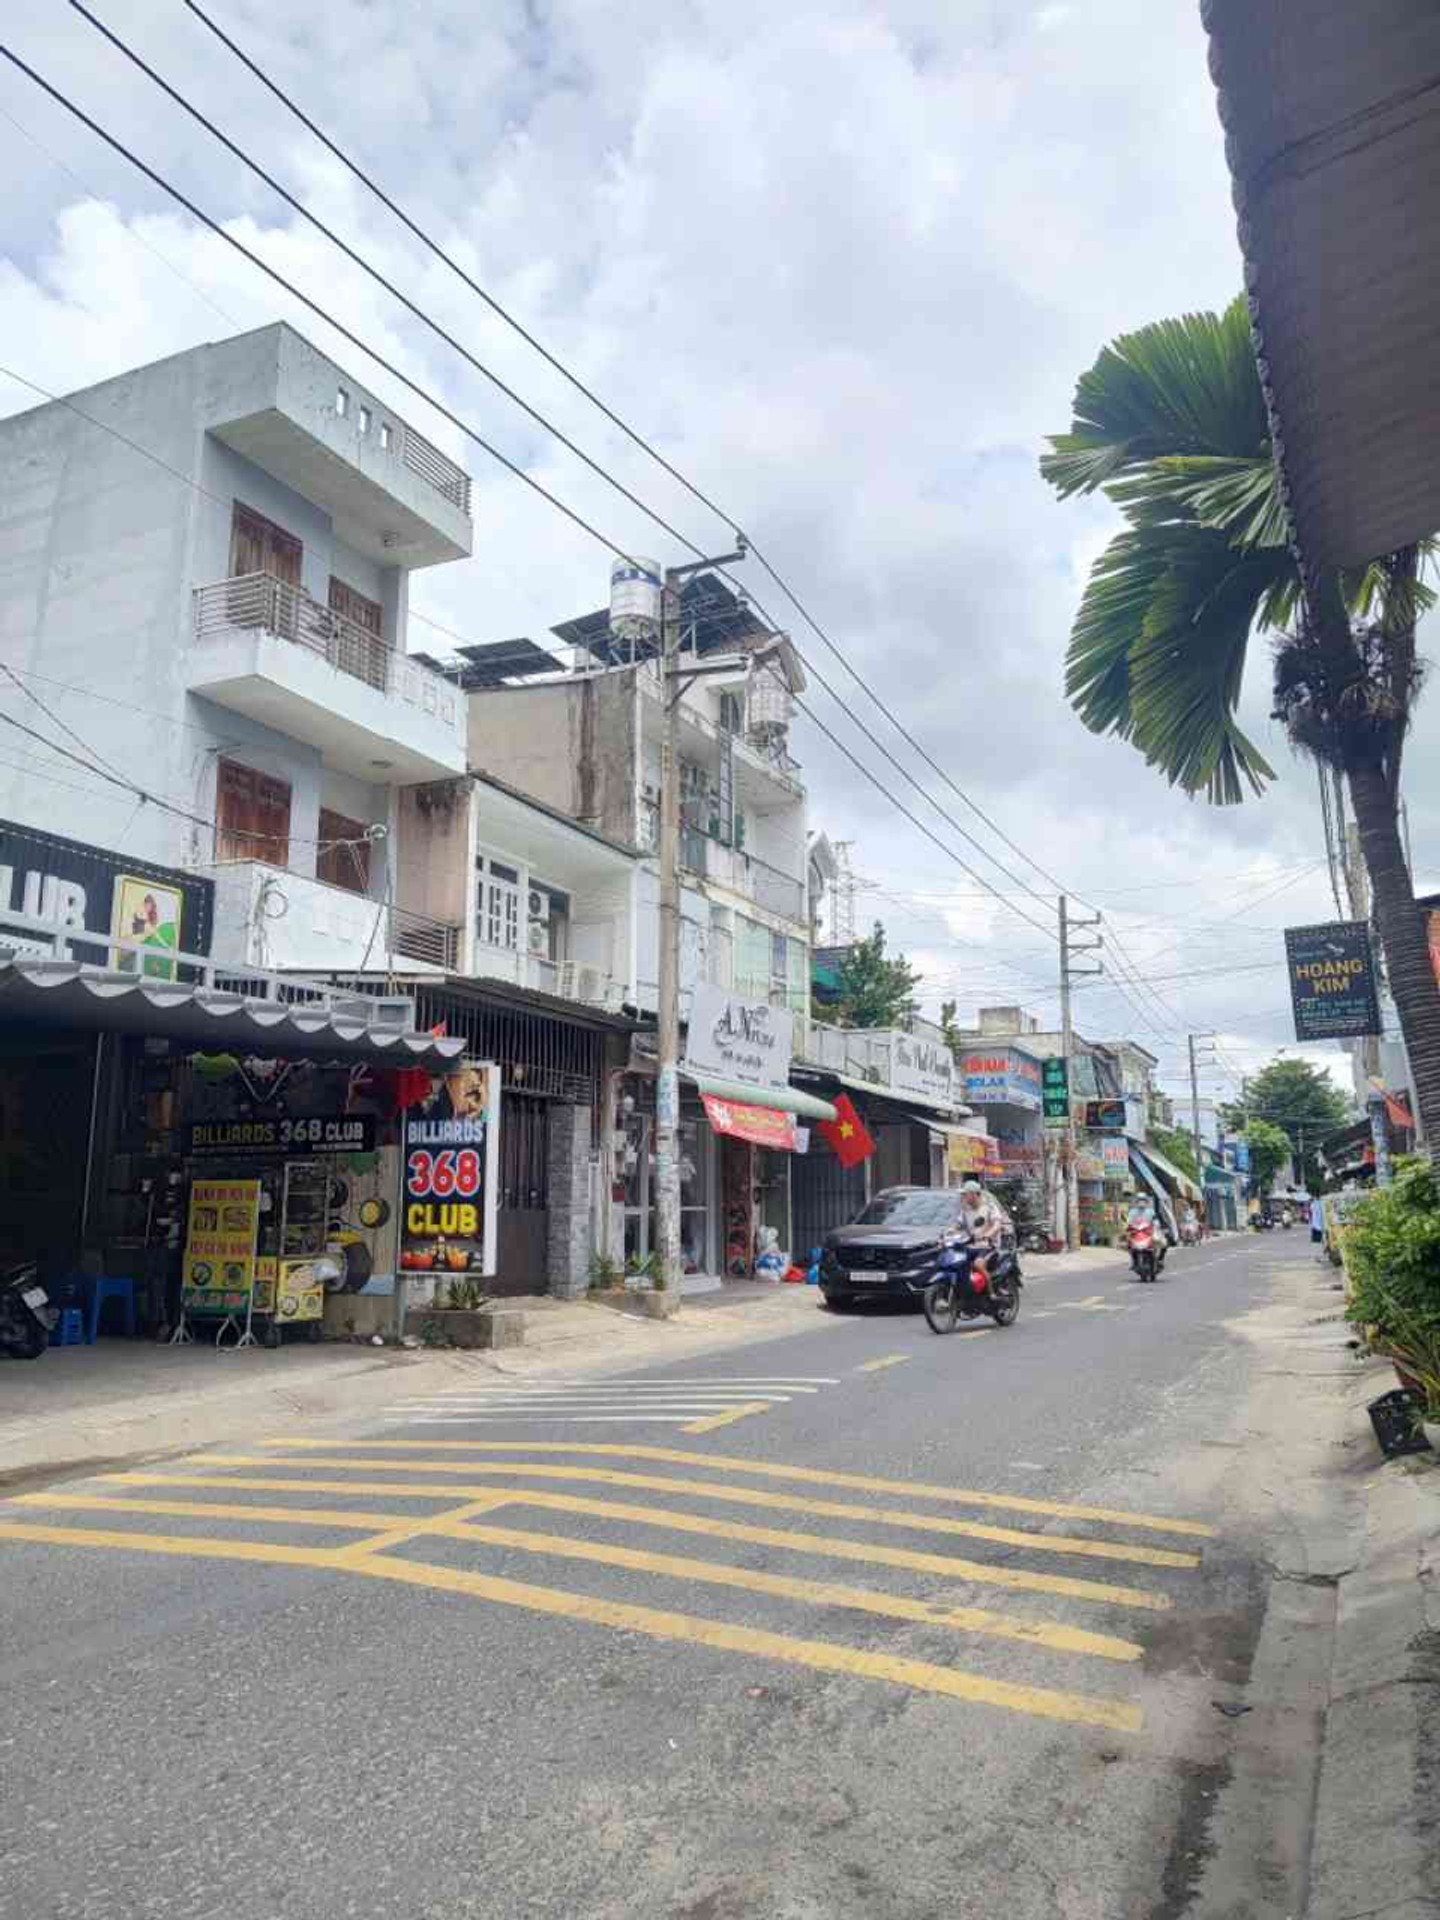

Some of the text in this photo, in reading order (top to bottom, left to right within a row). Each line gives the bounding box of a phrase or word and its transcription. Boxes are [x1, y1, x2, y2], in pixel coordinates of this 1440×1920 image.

[1313, 977, 1350, 996] KIM
[280, 1119, 322, 1142] 368
[325, 1122, 364, 1141] CLUB
[408, 1151, 480, 1196] 368
[407, 1204, 479, 1235] CLUB
